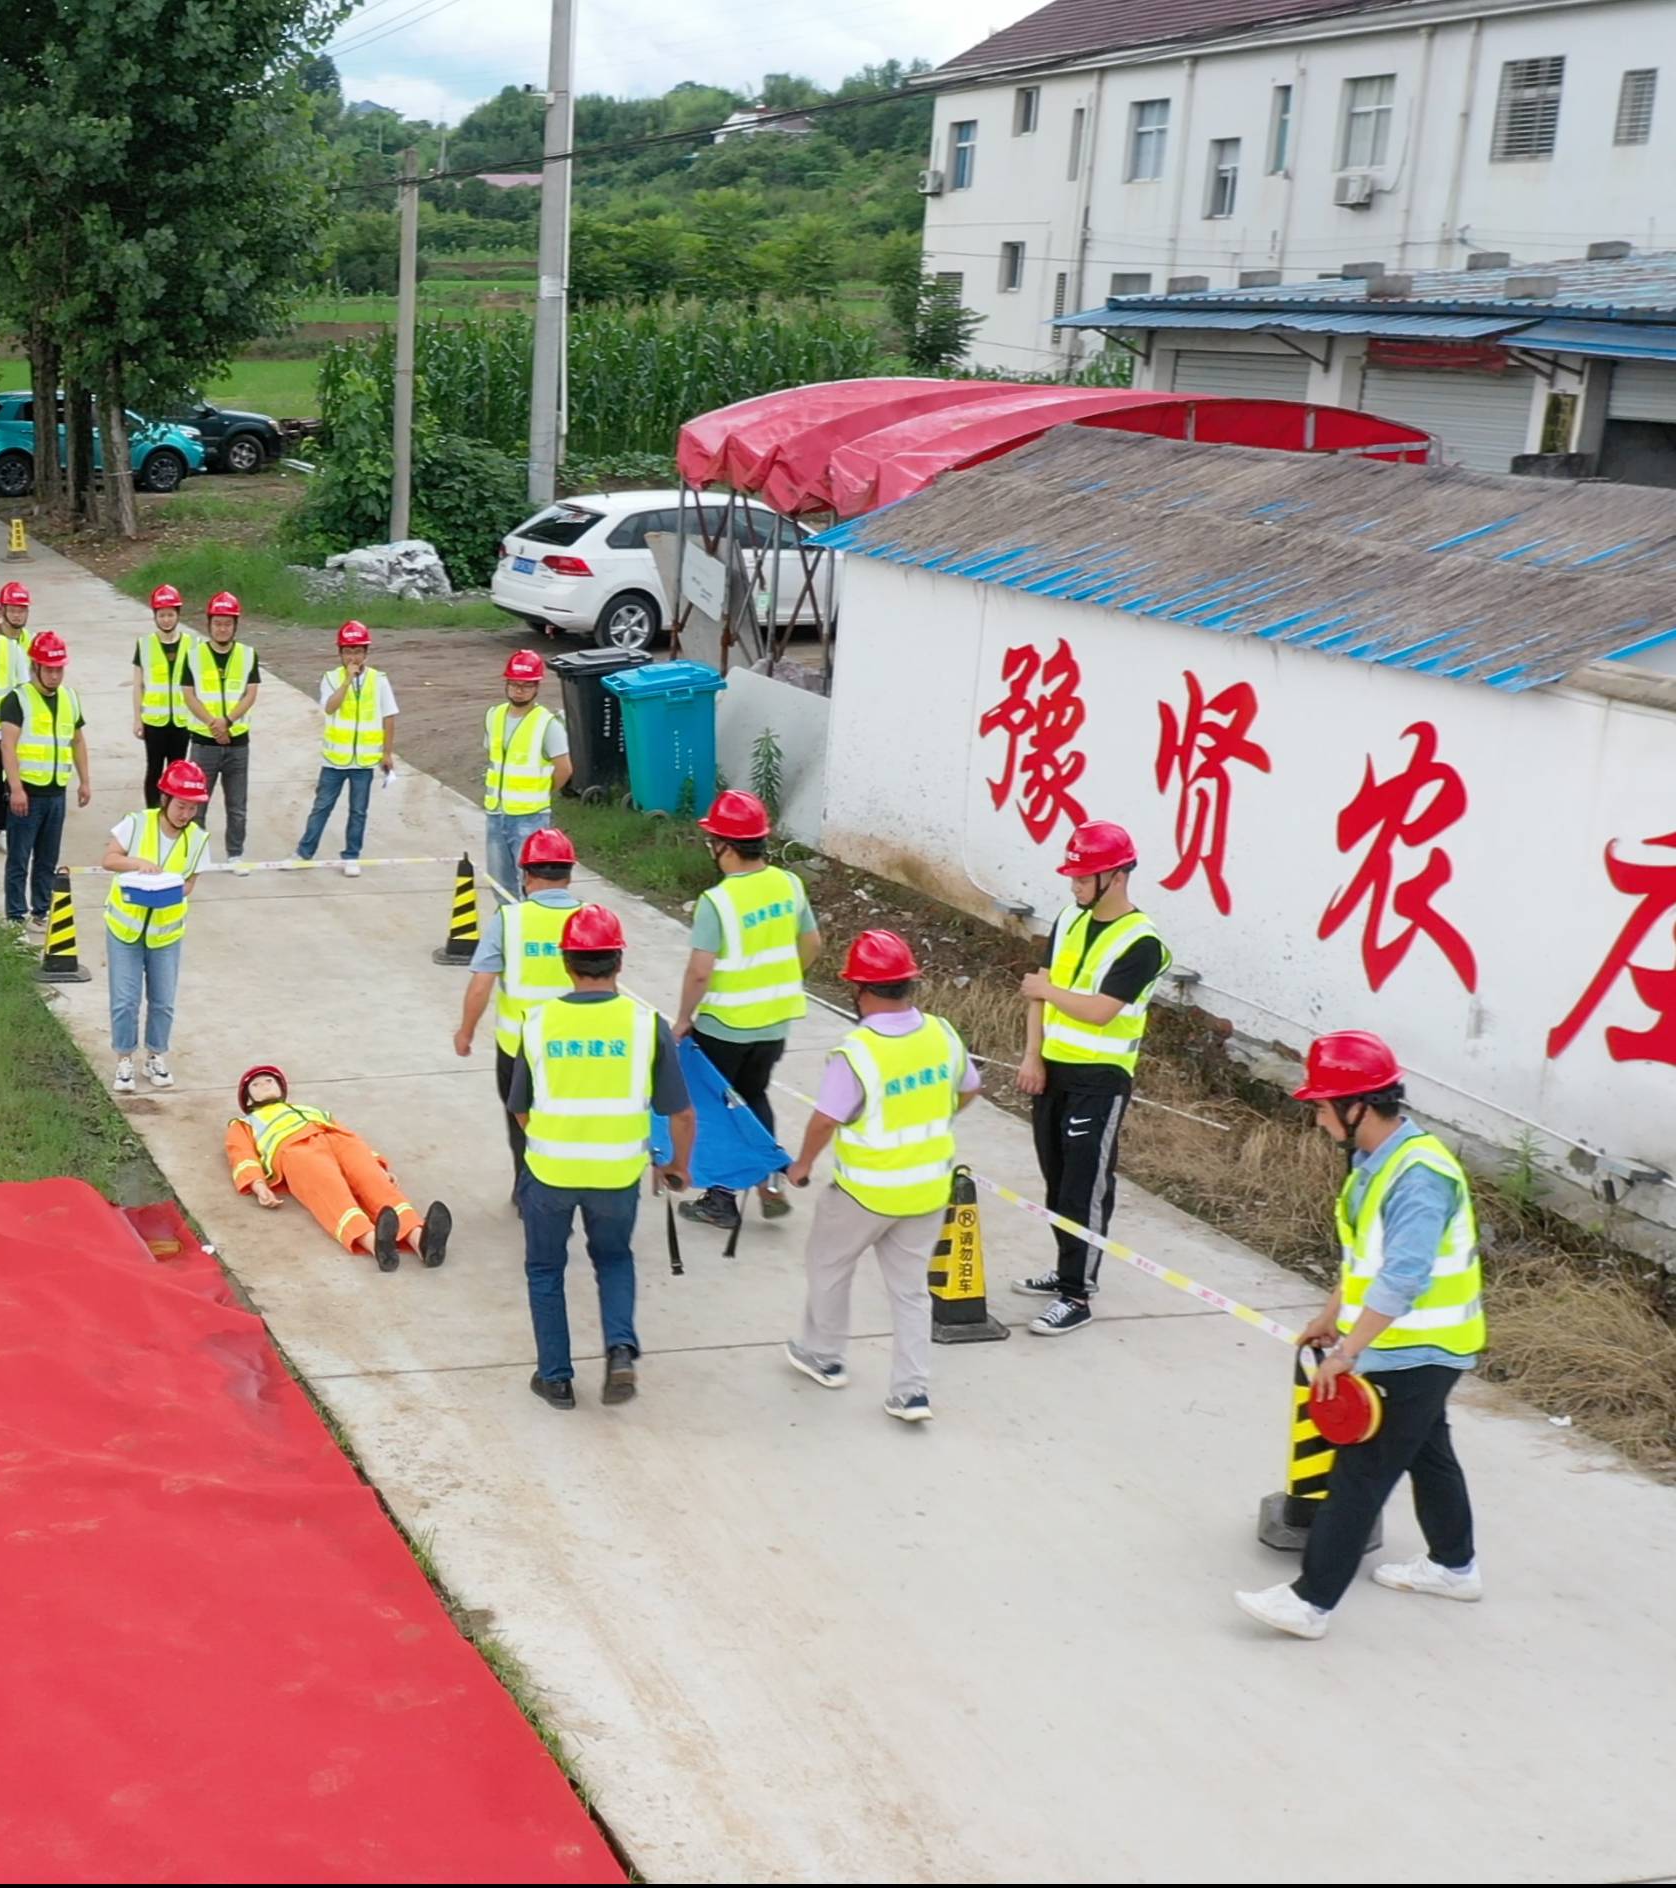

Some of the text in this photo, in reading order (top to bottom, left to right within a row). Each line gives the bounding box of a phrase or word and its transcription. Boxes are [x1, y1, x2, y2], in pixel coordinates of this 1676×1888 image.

[742, 899, 794, 929] 国衡建设
[546, 1039, 627, 1058] 国衡建设
[885, 1063, 949, 1097] 国衡建设
[958, 1231, 974, 1294] 请勿泊车
